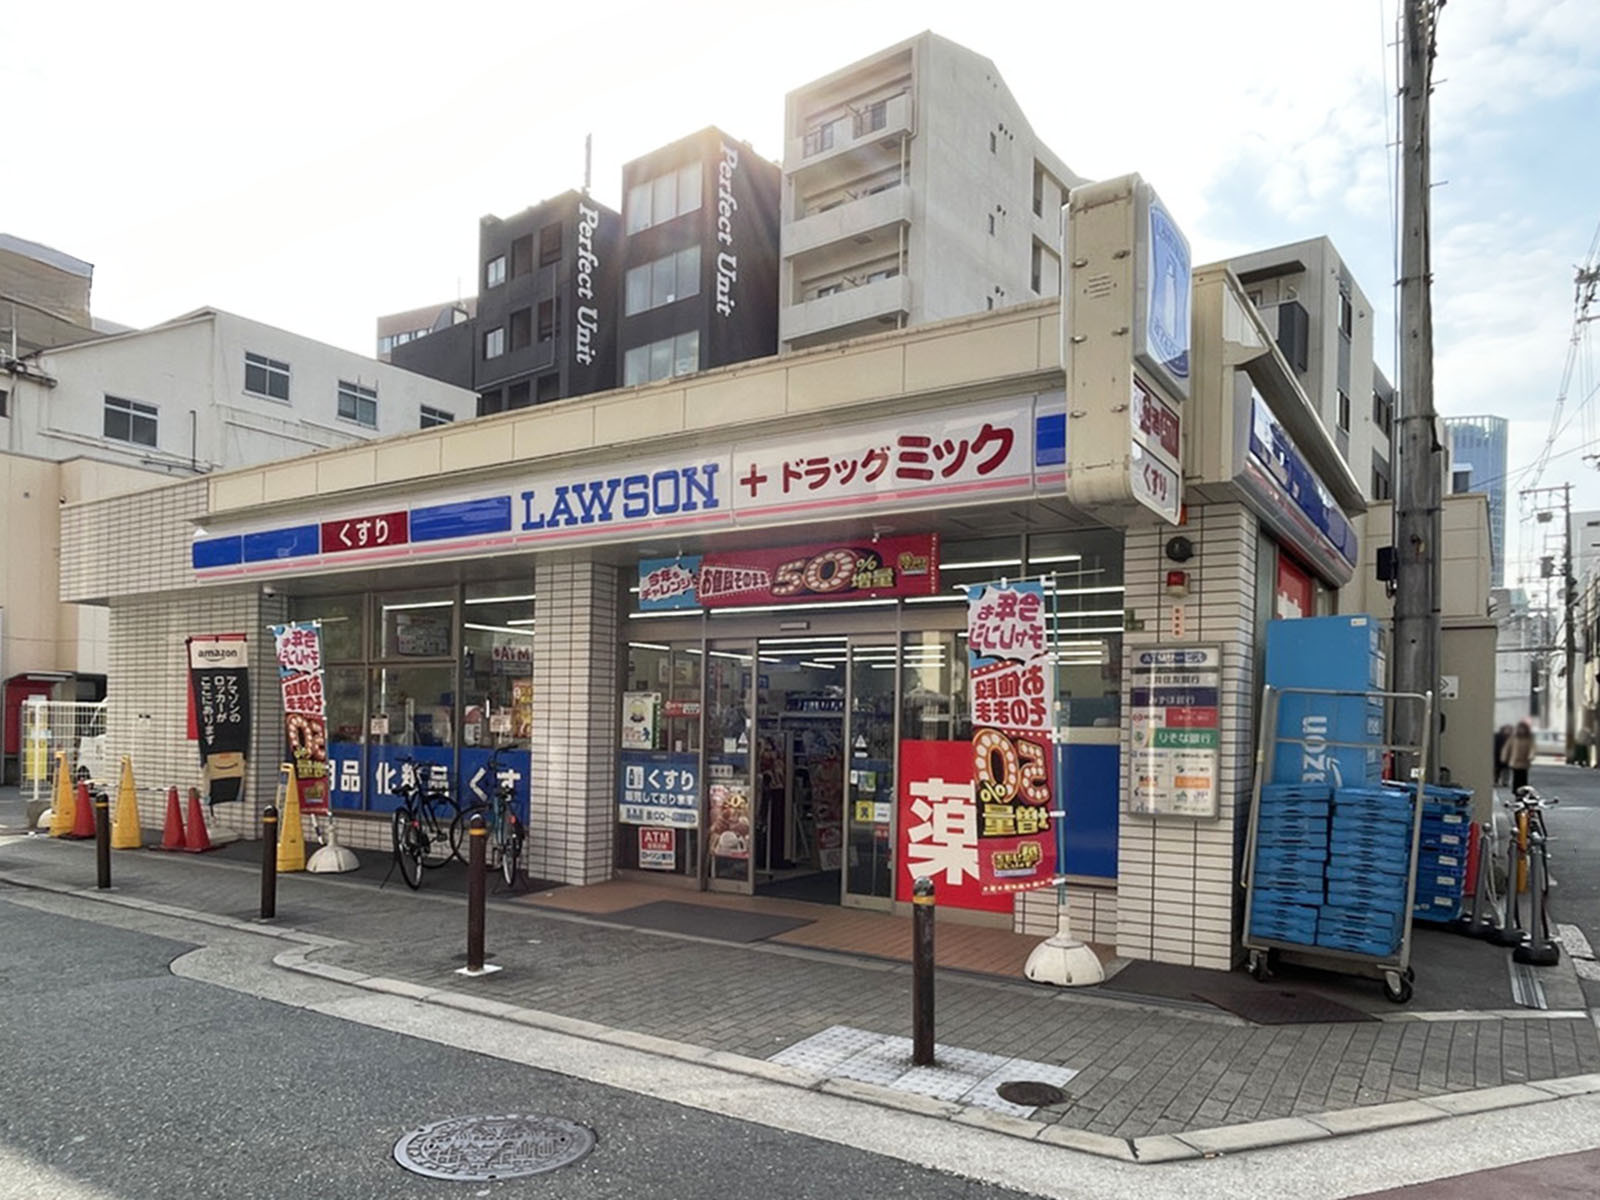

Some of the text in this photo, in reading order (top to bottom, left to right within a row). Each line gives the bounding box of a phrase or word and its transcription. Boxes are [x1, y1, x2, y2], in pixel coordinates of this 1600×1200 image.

[716, 141, 739, 316] Perfect Unit
[576, 202, 600, 365] Perfect Unit
[521, 463, 720, 530] LAWSON
[1143, 463, 1167, 501] くすり
[339, 518, 389, 547] くすり
[851, 567, 894, 589] 増量
[198, 647, 238, 658] amazon
[201, 676, 215, 746] ここにあります
[214, 675, 227, 723] ロッカーが
[227, 676, 241, 723] アマゾンの
[648, 769, 694, 791] くすり
[645, 832, 670, 843] ATM
[907, 777, 981, 886] 薬
